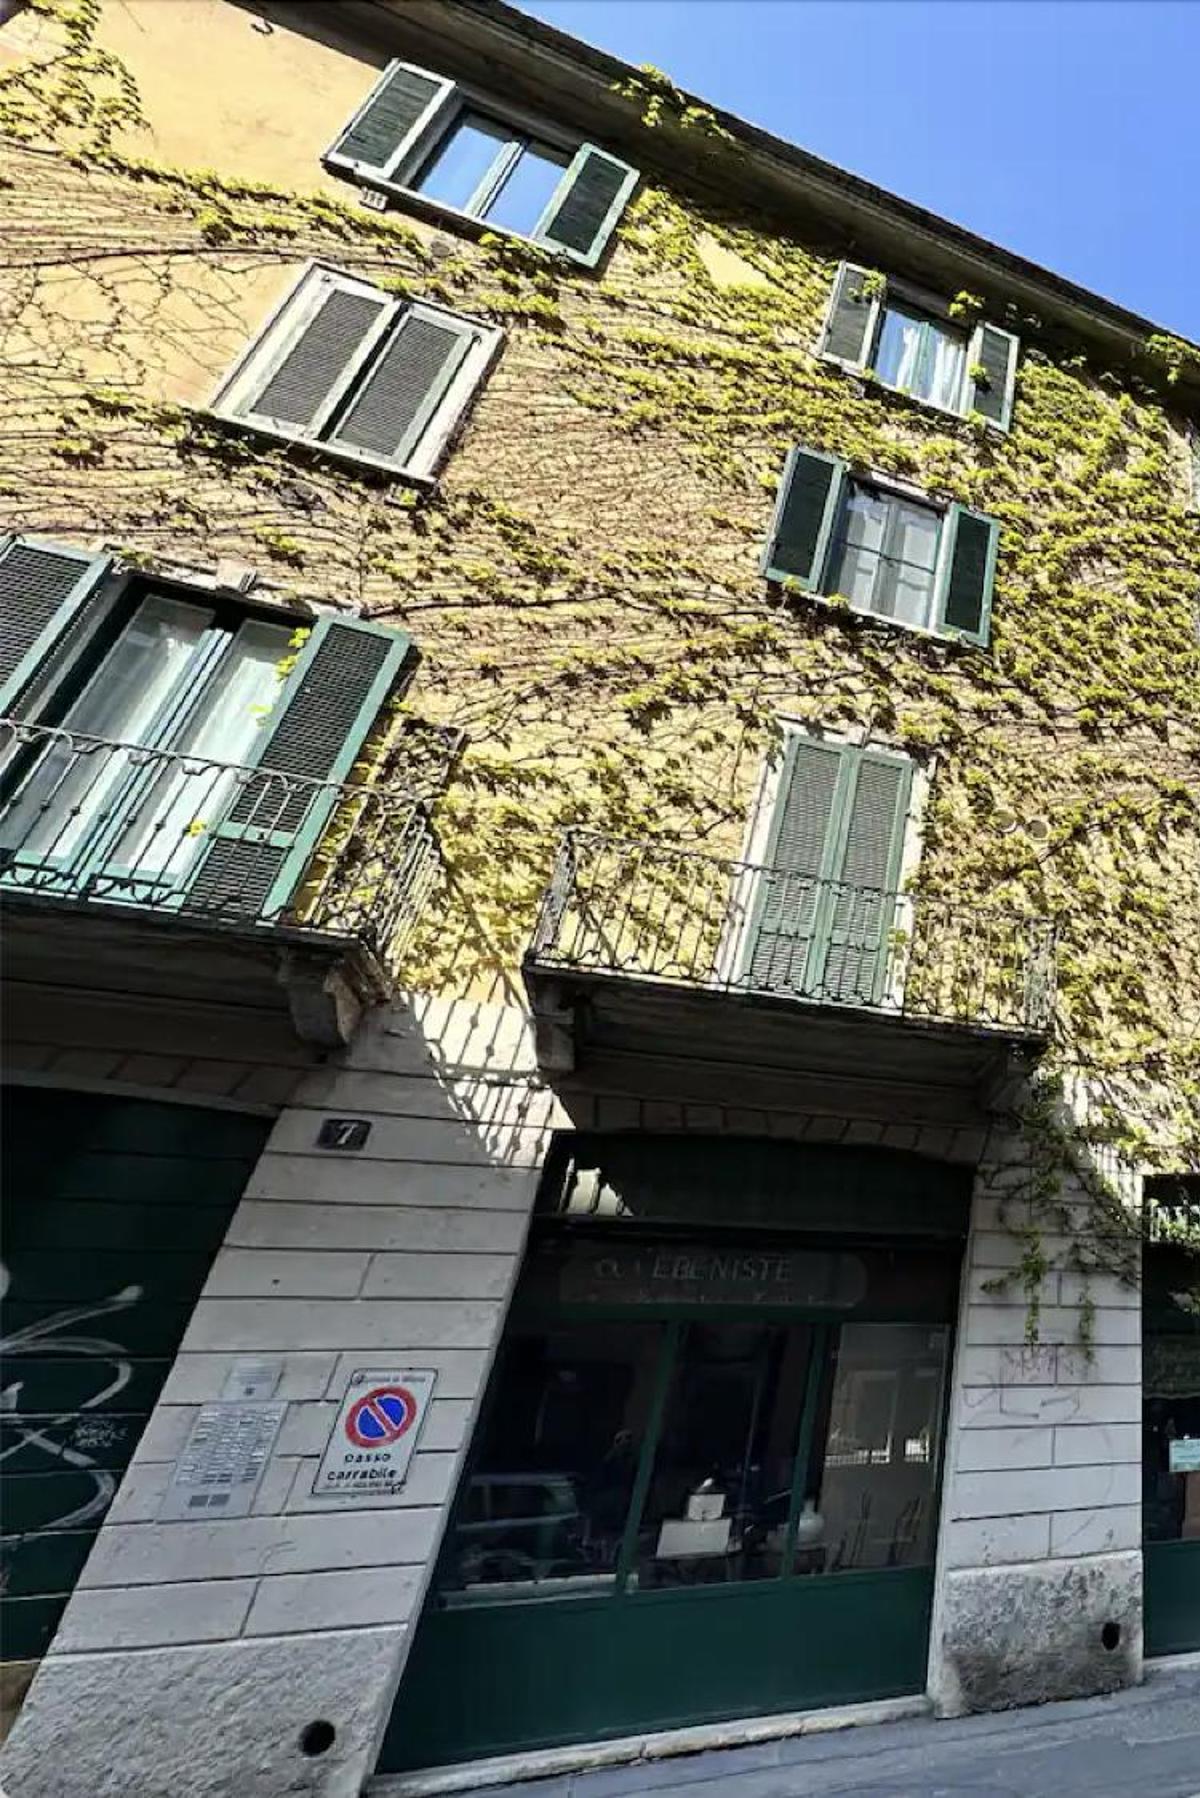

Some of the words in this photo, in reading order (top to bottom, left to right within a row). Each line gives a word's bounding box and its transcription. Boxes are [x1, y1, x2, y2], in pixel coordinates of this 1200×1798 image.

[337, 1121, 359, 1145] 7
[343, 1452, 392, 1464] passo
[326, 1467, 399, 1481] carrabile
